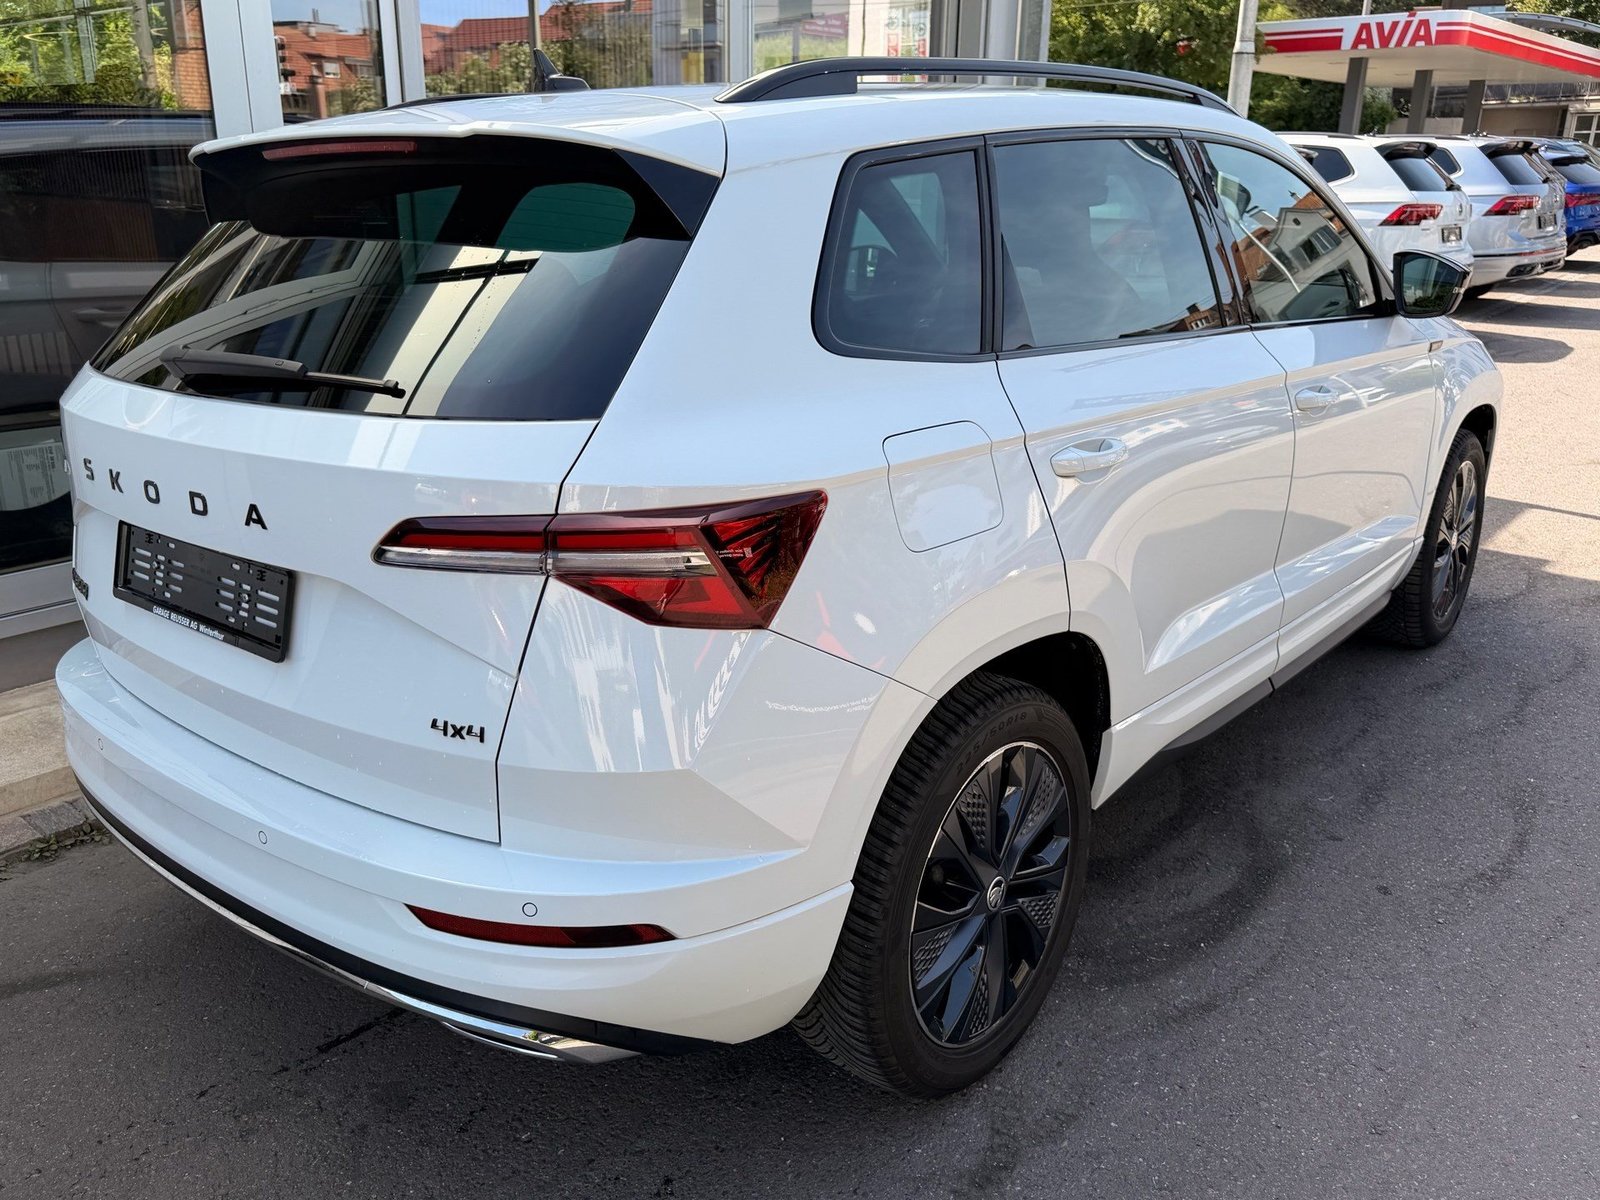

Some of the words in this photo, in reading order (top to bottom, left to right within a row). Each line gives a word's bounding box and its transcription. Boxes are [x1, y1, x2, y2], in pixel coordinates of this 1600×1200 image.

[1350, 11, 1434, 50] AVIA
[83, 457, 268, 530] SKODA
[152, 605, 170, 619] GARAGE
[170, 612, 190, 627] REUSSER
[189, 620, 198, 630] AG
[199, 624, 224, 640] Winterthur
[430, 717, 485, 744] 4x4
